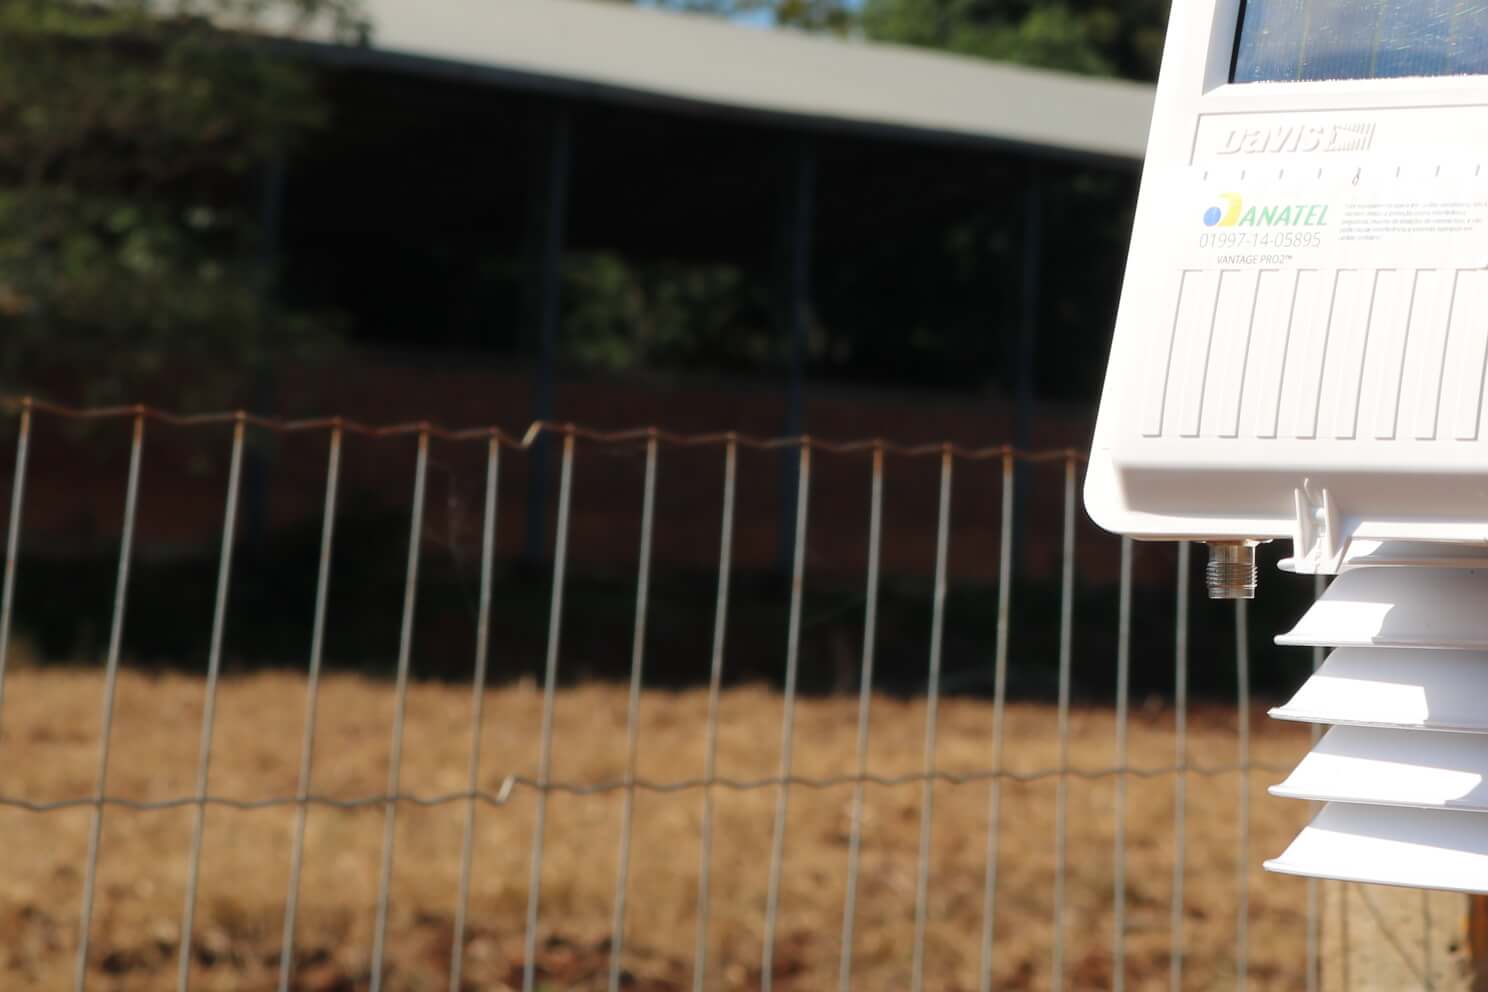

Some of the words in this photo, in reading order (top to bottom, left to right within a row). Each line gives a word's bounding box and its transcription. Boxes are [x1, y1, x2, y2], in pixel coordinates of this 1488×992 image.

[1239, 204, 1329, 226] ANATEL
[1198, 231, 1322, 248] 01997-14-05895
[1217, 254, 1258, 265] VANTAGE
